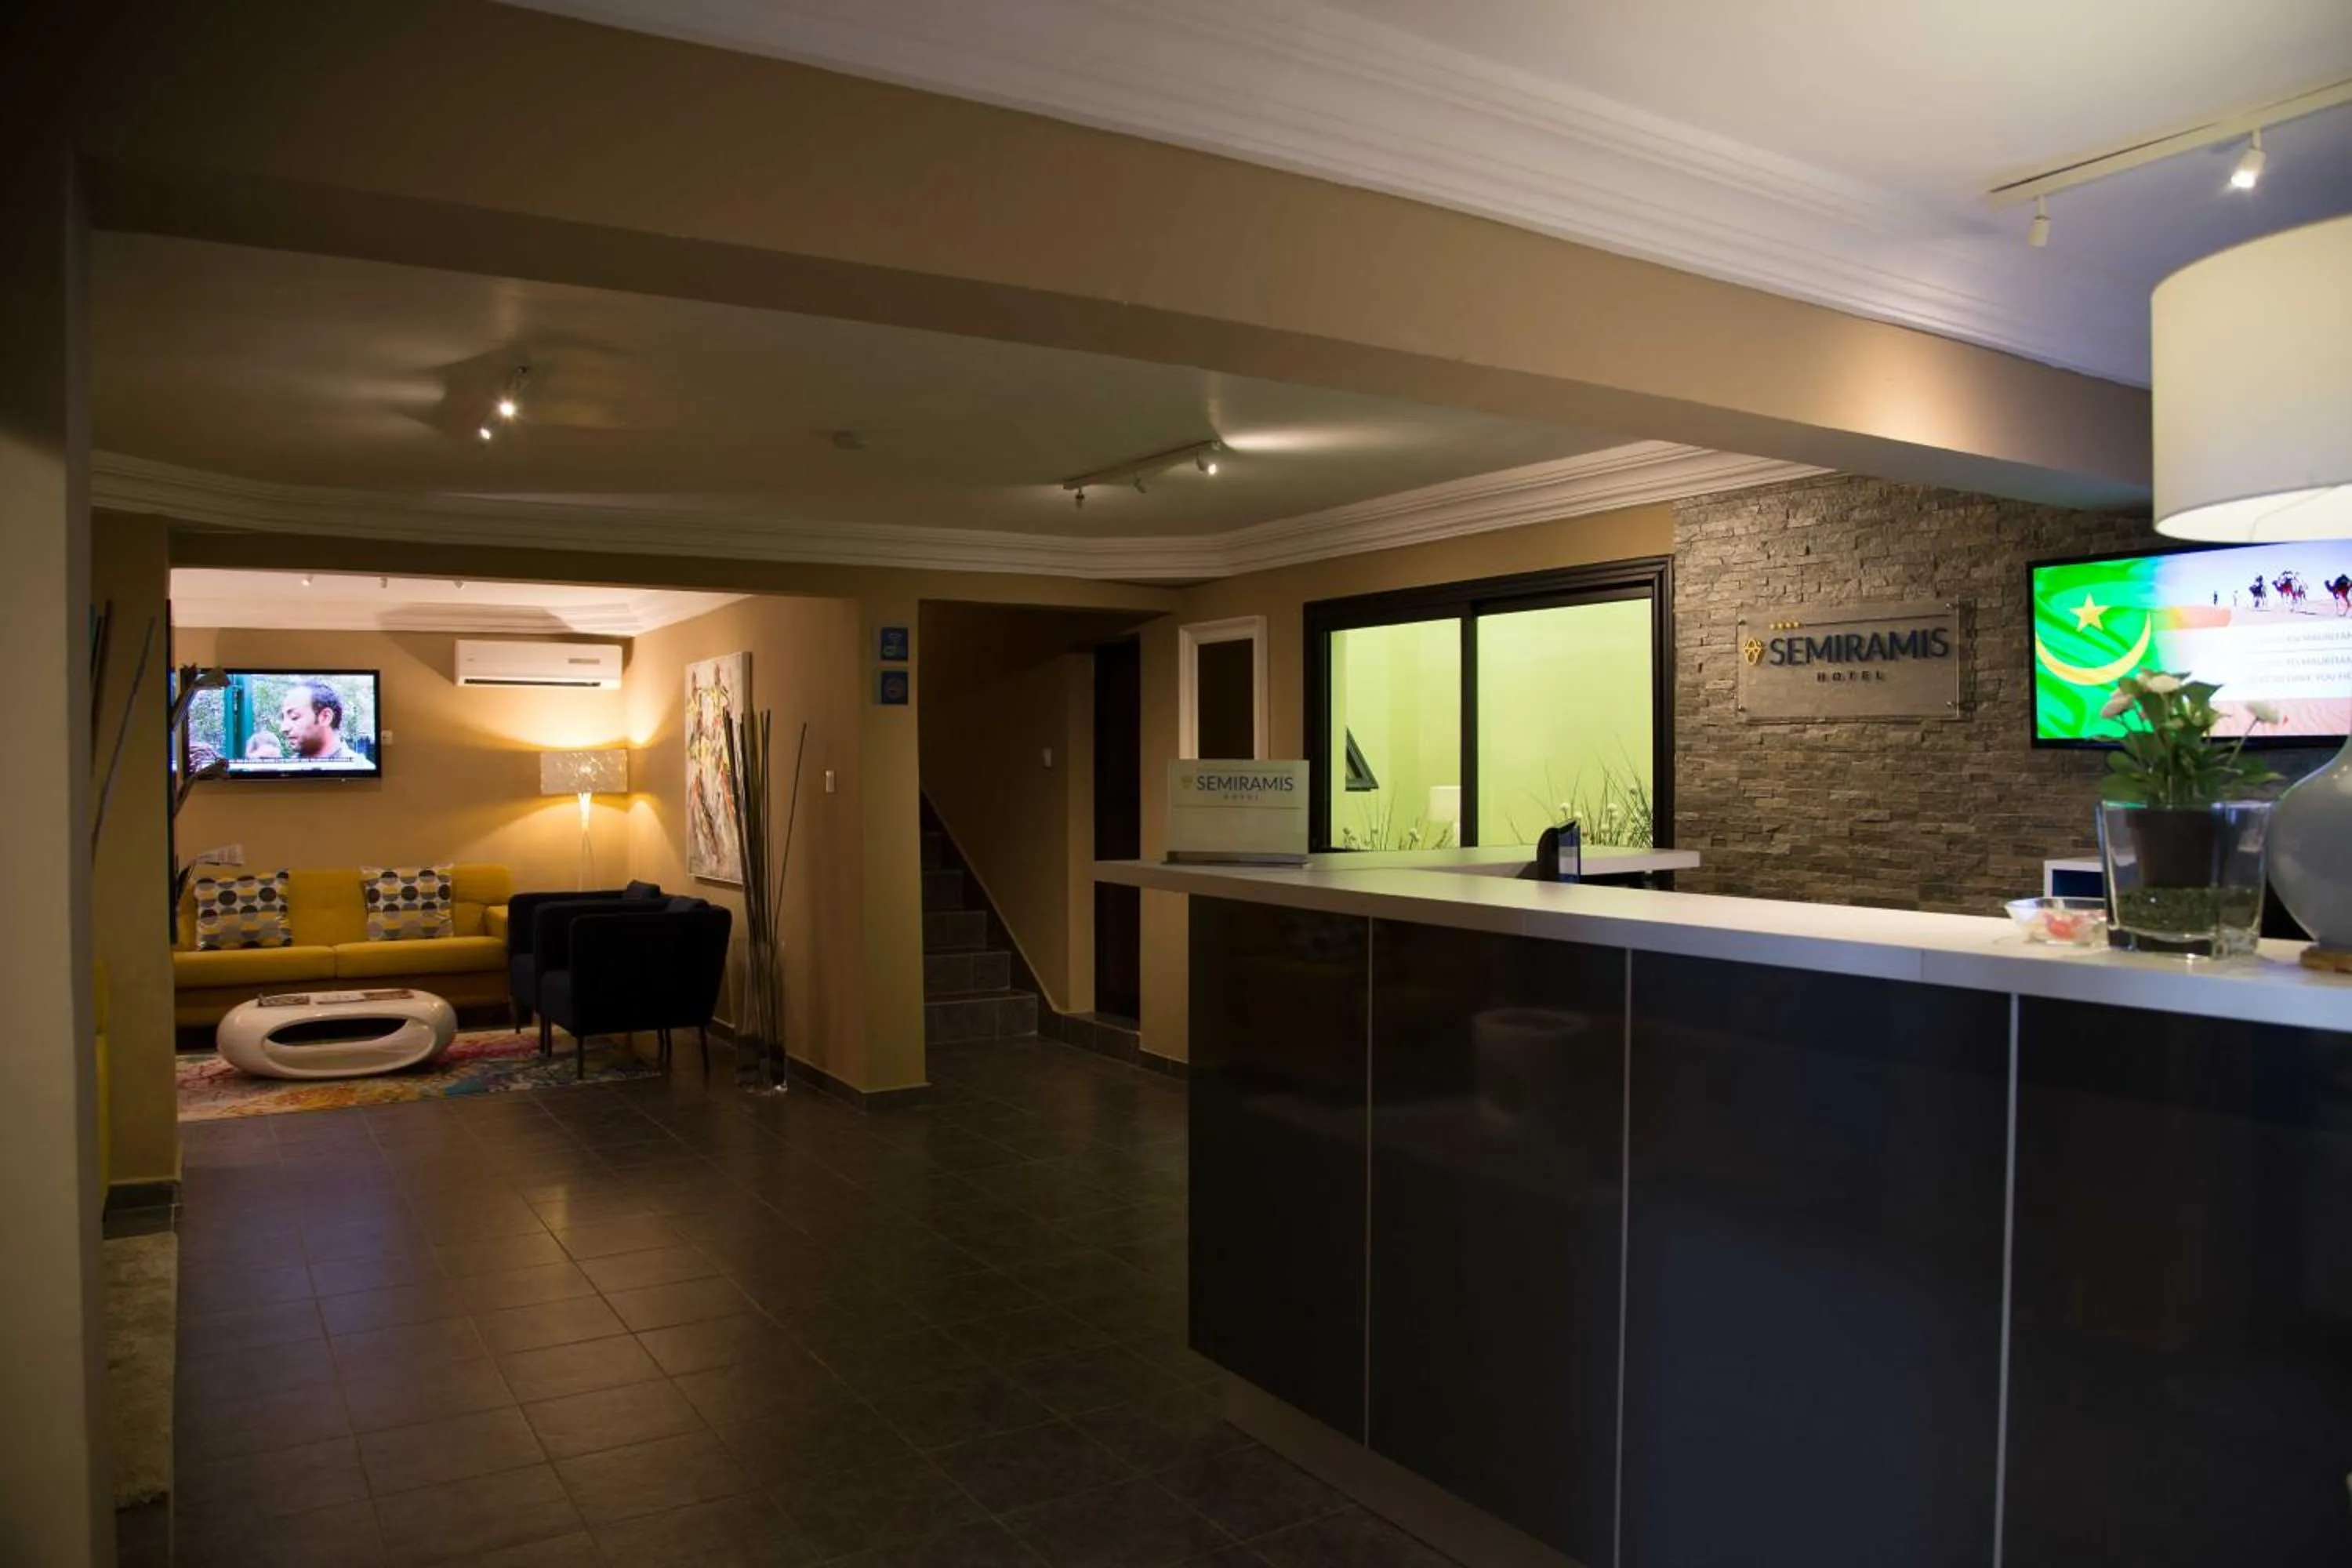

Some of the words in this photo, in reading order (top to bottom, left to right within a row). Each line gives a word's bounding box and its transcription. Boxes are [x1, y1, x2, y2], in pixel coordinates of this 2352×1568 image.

[1769, 628, 1949, 665] SEMIRAMIS
[1817, 671, 1886, 682] HOTEL
[1196, 775, 1294, 792] SEMIRAMIS
